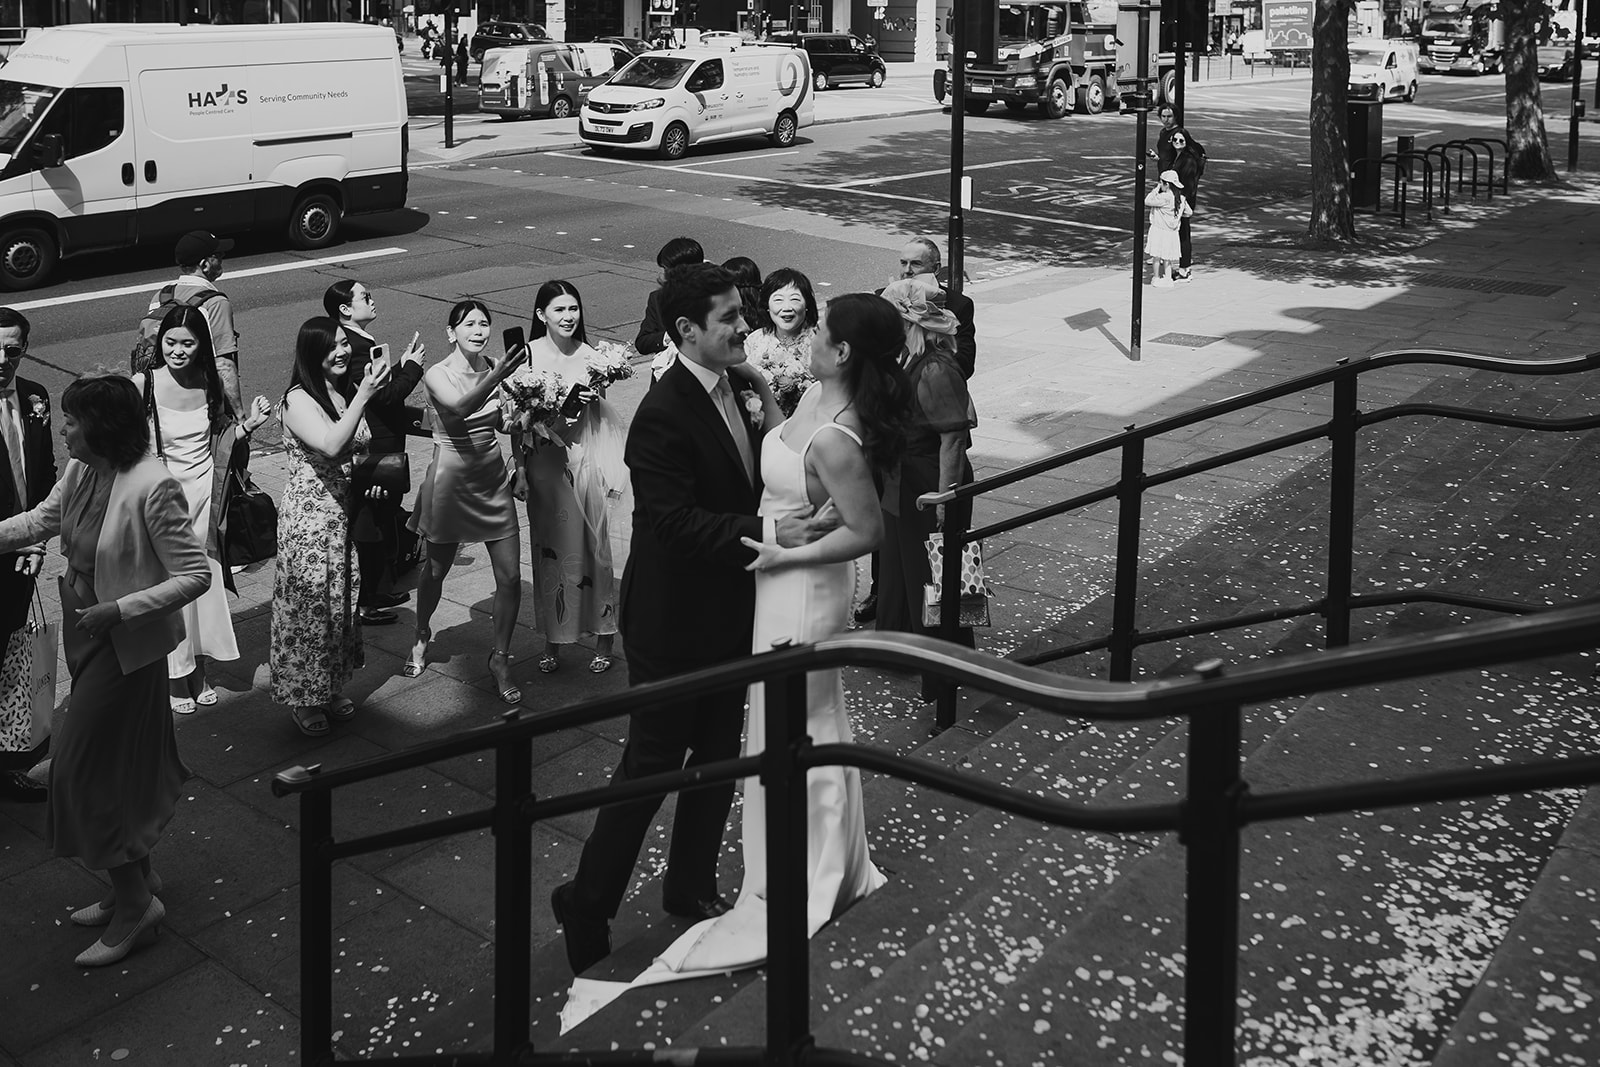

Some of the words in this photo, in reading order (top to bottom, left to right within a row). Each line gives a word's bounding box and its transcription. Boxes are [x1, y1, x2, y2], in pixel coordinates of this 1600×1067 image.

[1269, 5, 1309, 18] palletline
[259, 95, 286, 103] Serving
[287, 93, 326, 102] Community
[328, 90, 348, 98] Needs
